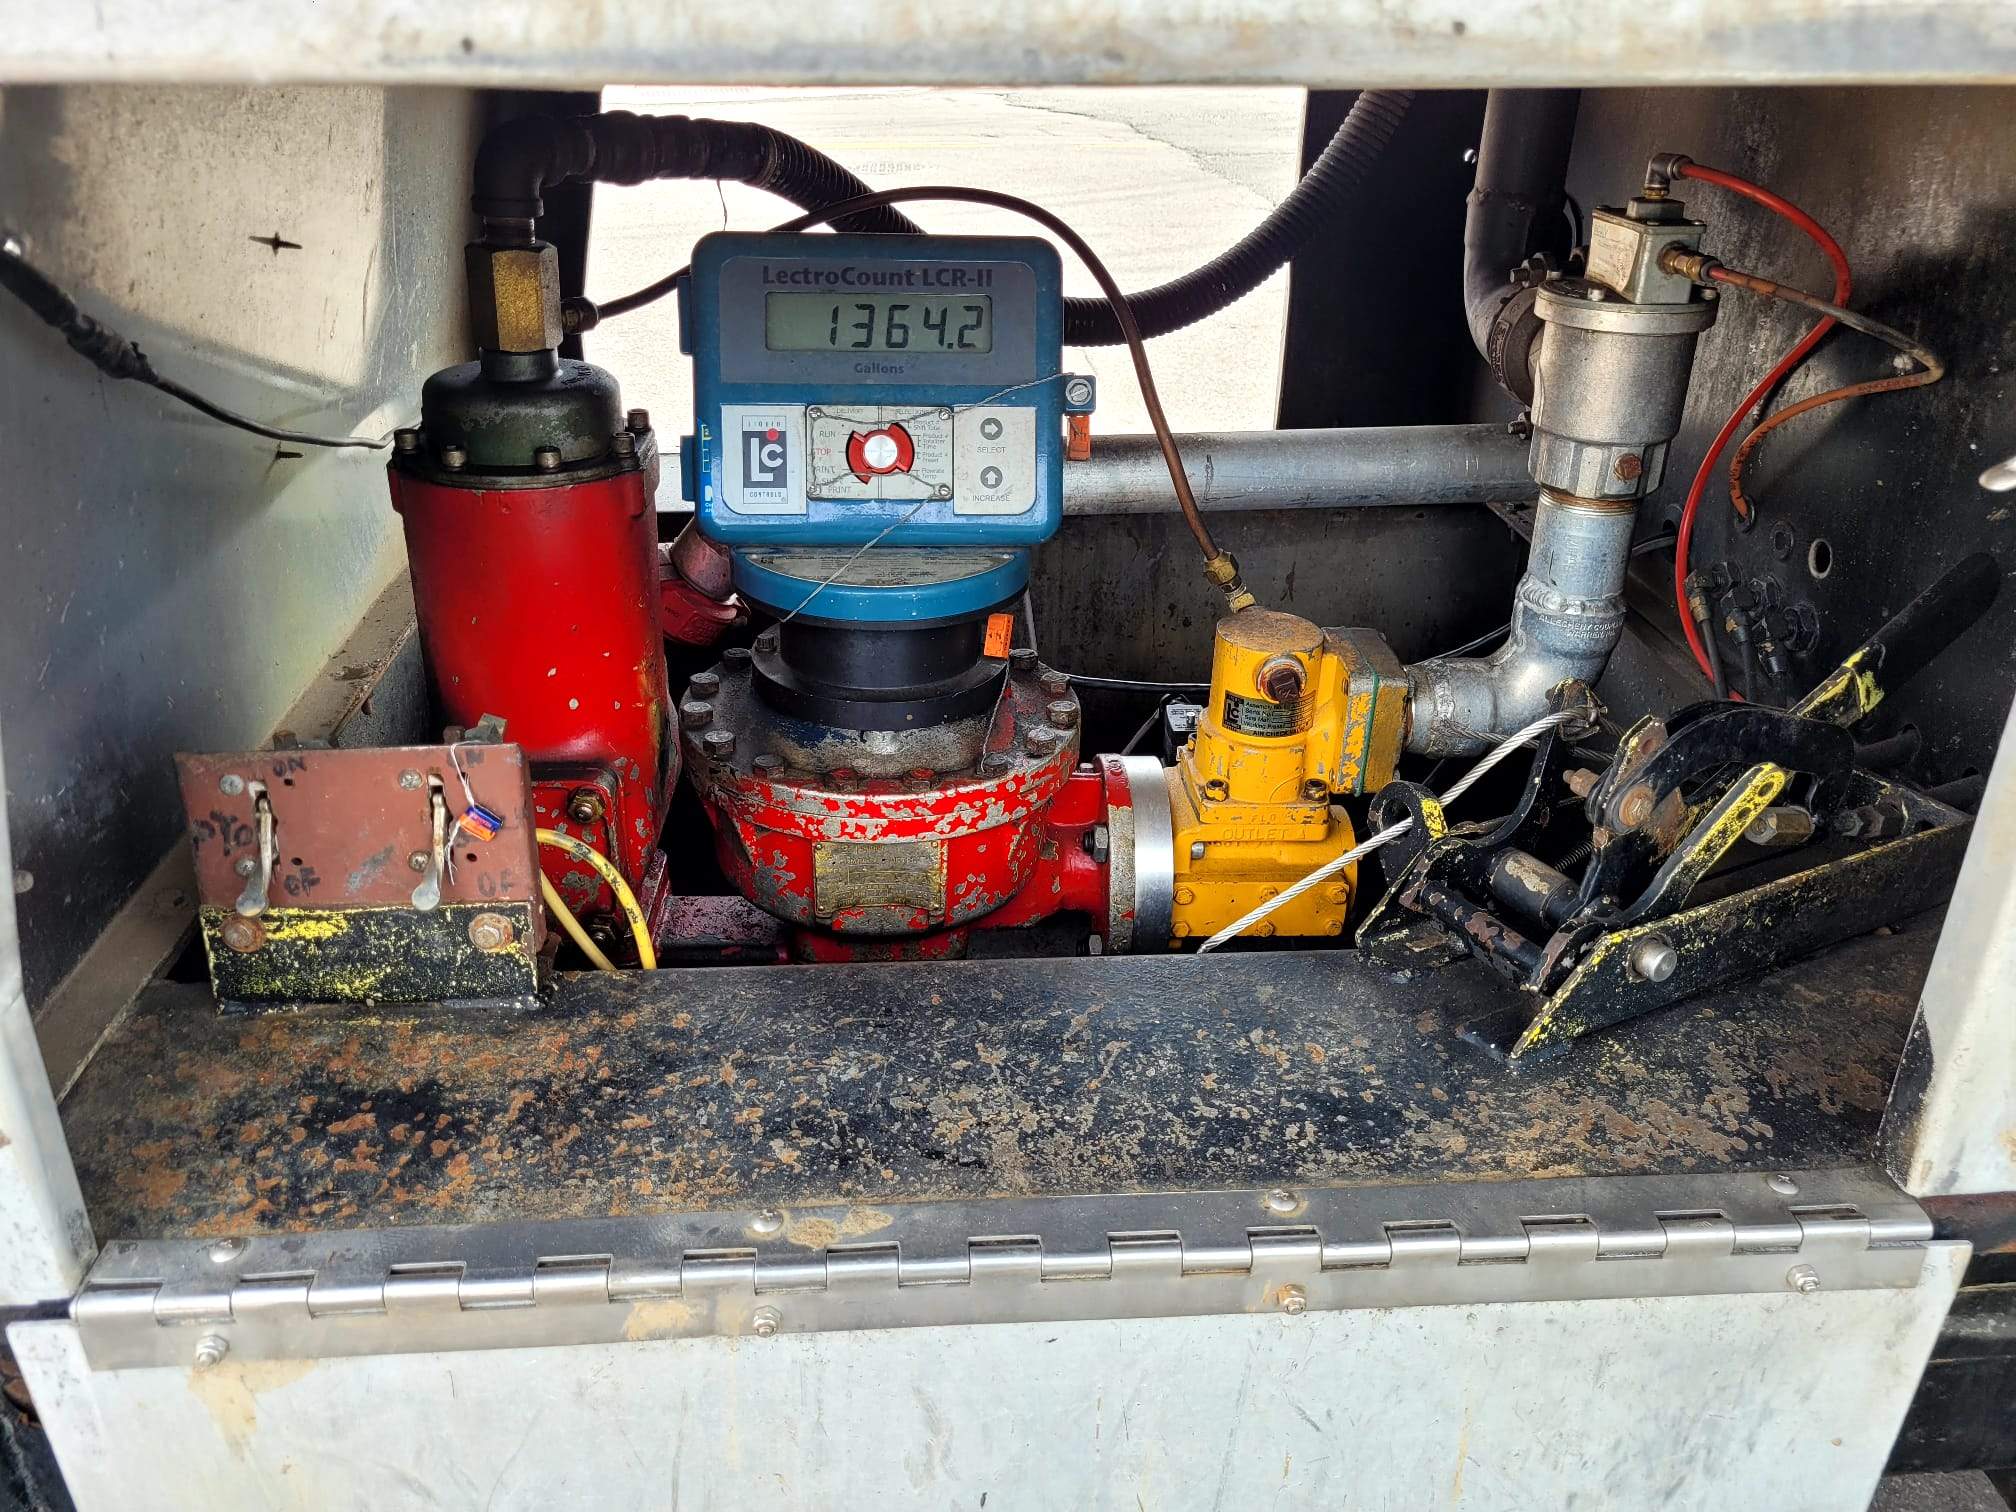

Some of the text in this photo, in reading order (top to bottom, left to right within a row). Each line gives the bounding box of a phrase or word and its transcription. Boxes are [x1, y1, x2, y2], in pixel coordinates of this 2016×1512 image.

[762, 266, 993, 288] LectroCount LCR-II
[829, 303, 984, 350] 1364.2
[854, 362, 905, 375] Gallons
[819, 430, 836, 438] RUN
[976, 446, 1006, 454] SELECT
[972, 494, 1011, 502] INCREASE
[272, 756, 307, 777] ON
[192, 809, 254, 857] PTO
[1222, 827, 1290, 841] OUTLET
[477, 869, 514, 897] OF
